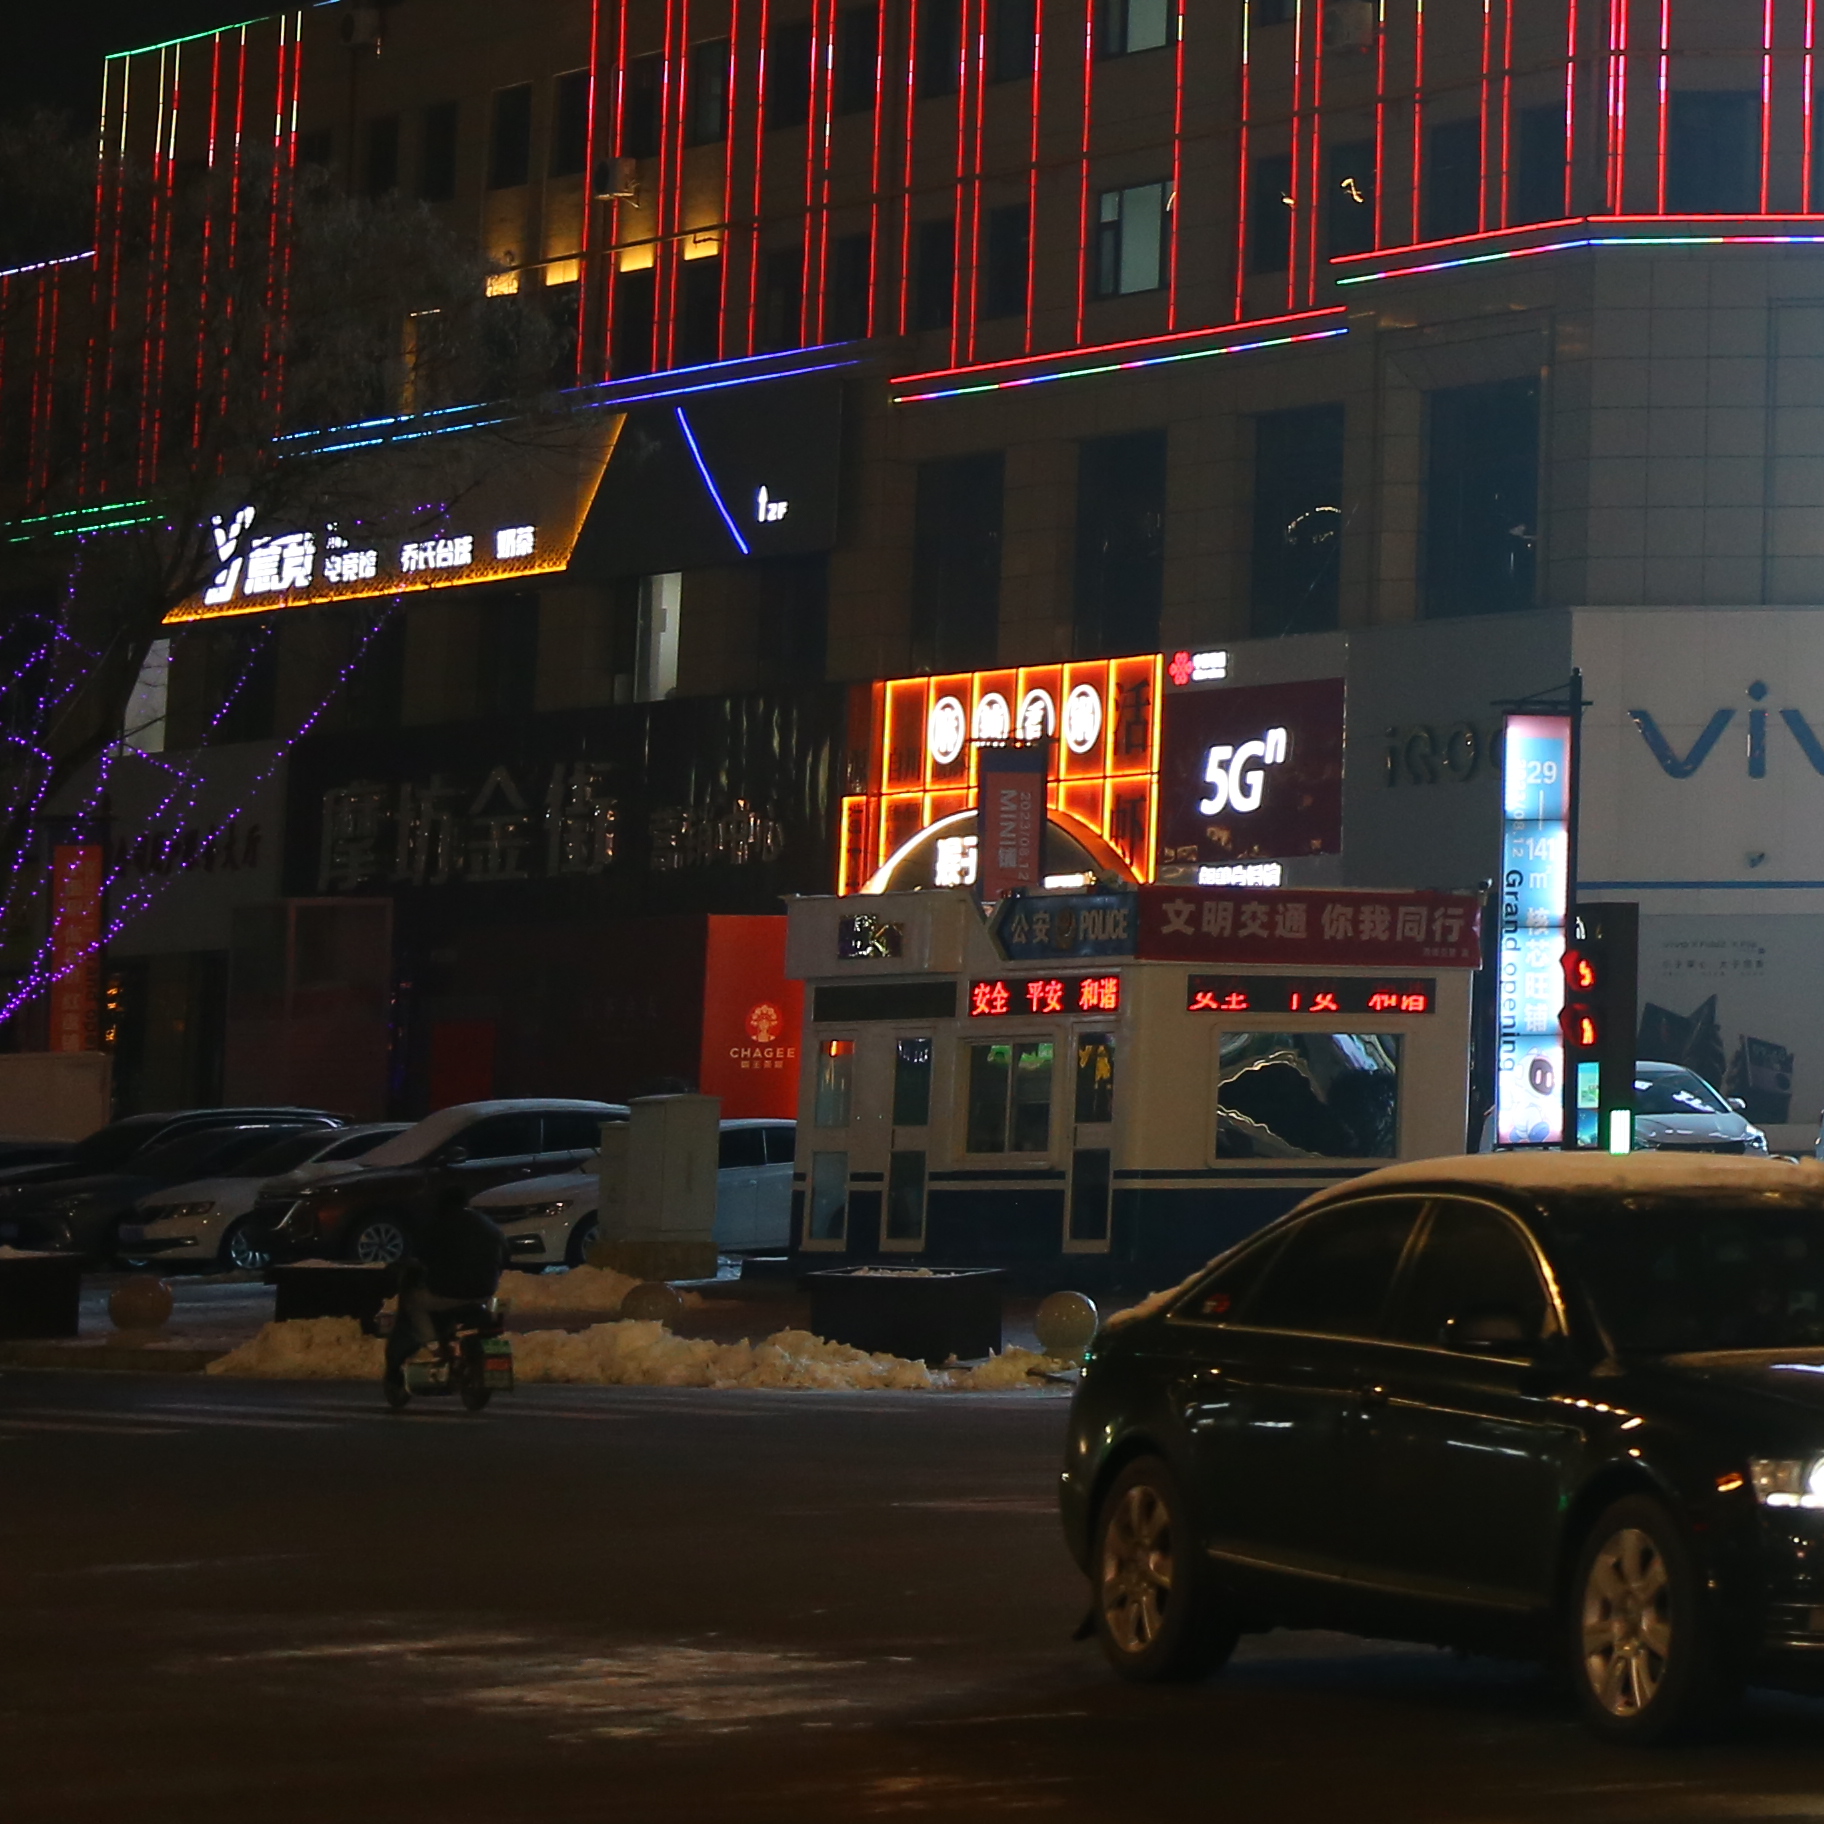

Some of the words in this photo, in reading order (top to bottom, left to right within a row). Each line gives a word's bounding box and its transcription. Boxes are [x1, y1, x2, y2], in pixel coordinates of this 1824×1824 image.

[1527, 761, 1558, 784] 29
[1079, 908, 1130, 942] POLICE
[1161, 898, 1308, 940] 文明交通
[1321, 903, 1466, 944] 你我同行
[1504, 869, 1524, 951] Grand
[1011, 912, 1052, 945] 公安
[971, 981, 1008, 1015] 安全
[1027, 979, 1064, 1013] 平安
[1078, 977, 1119, 1011] 和谐
[1499, 954, 1520, 1072] opening
[729, 1047, 796, 1059] CHAGEE
